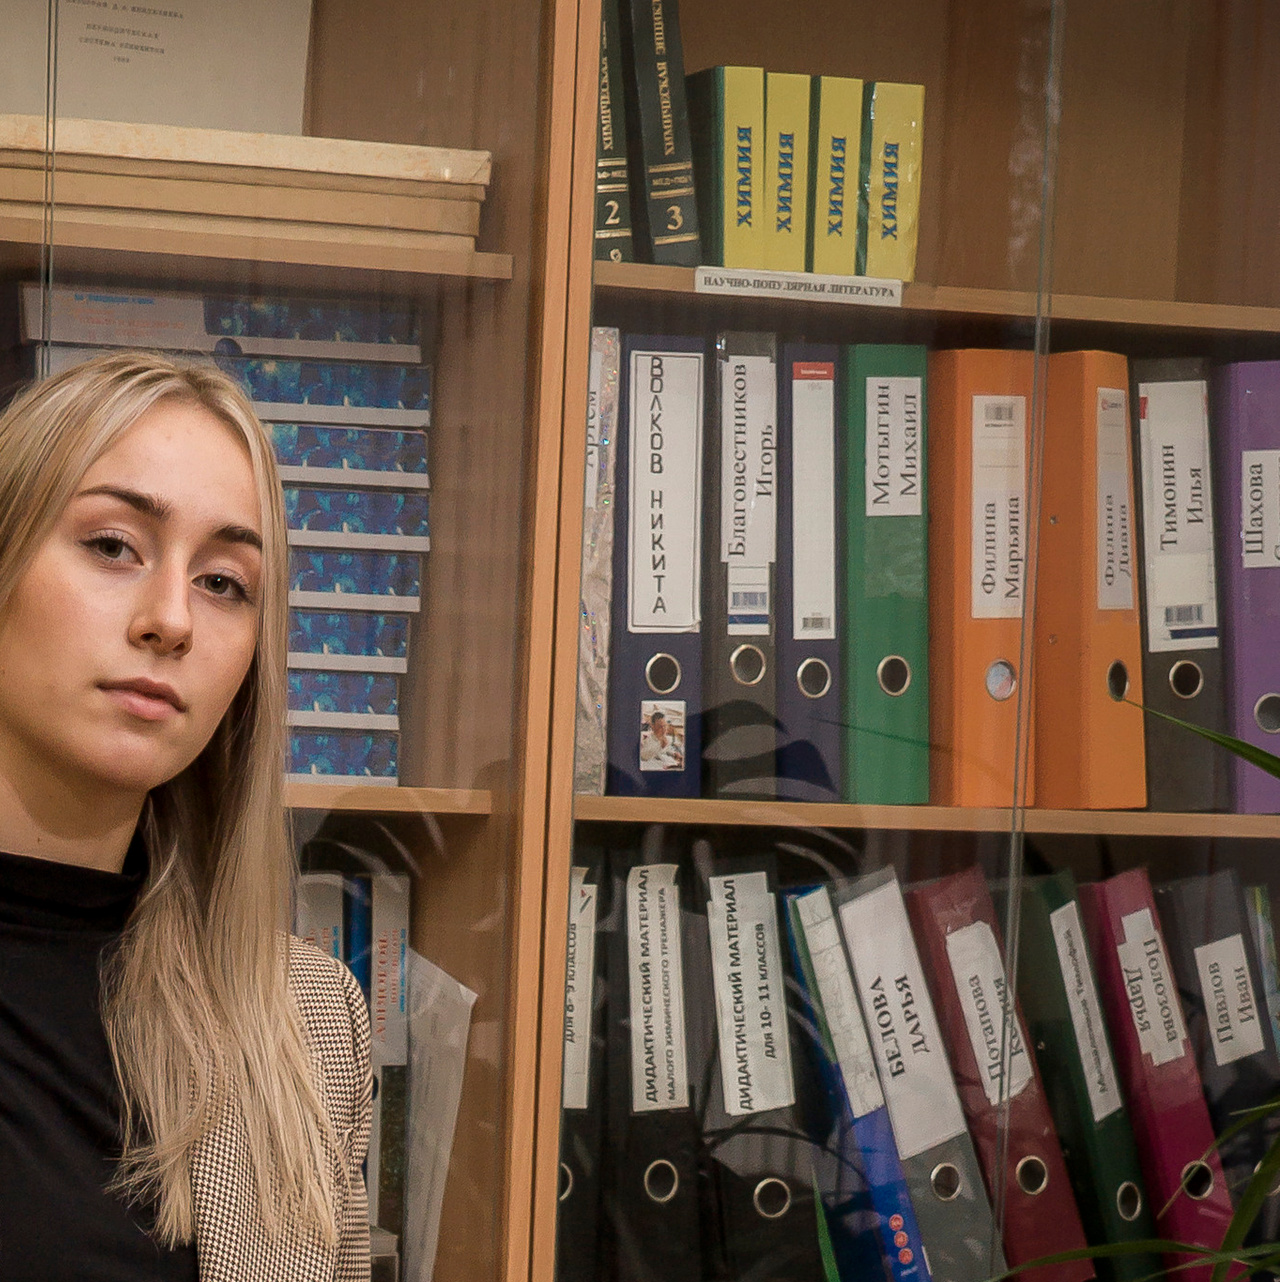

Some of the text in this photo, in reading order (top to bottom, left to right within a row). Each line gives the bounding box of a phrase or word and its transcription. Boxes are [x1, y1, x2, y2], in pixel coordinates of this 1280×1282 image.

[656, 61, 676, 156] ХИМИЧЕСКАЯ
[604, 199, 621, 225] 2
[666, 205, 684, 231] 3
[736, 126, 752, 228] ХИМИЯ
[776, 132, 795, 233] ХИМИЯ
[827, 136, 847, 237] ХИМИЯ
[881, 142, 900, 241] ХИМИЯ
[703, 275, 895, 299] НАУЧНО-ПОПУЛЯРНАЯ ЛИТЕРАТУРА
[649, 356, 667, 614] ВОЛКОВ НИКИТА
[728, 363, 747, 558] Благовестников
[756, 424, 778, 497] Игорь
[872, 384, 890, 506] Мотыгин
[900, 393, 917, 496] Михаил
[1104, 495, 1115, 587] Филина
[1159, 444, 1179, 552] Тимонин
[1187, 467, 1205, 525] Илья
[1244, 463, 1264, 556] Шахова
[980, 501, 997, 595] Филина
[1004, 496, 1024, 599] Марьяна
[636, 869, 659, 1103] ДИДАКТИЧЕСКИЙ МАТЕРИАЛ
[658, 887, 676, 1101] МАЛОГО ХИМИЧЕСКОГО ТРЕНАЖЕРА
[723, 879, 754, 1111] ДИДАКТИЧЕСКИЙ МАТЕРИАЛ
[868, 975, 906, 1078] БЕЛОВА
[894, 974, 931, 1054] ДАРЬЯ
[968, 974, 1006, 1081] Потапова
[1124, 967, 1150, 1033] Дарья
[1144, 938, 1179, 1043] Полозова
[1207, 961, 1234, 1044] Павлов
[1234, 967, 1256, 1024] Иван
